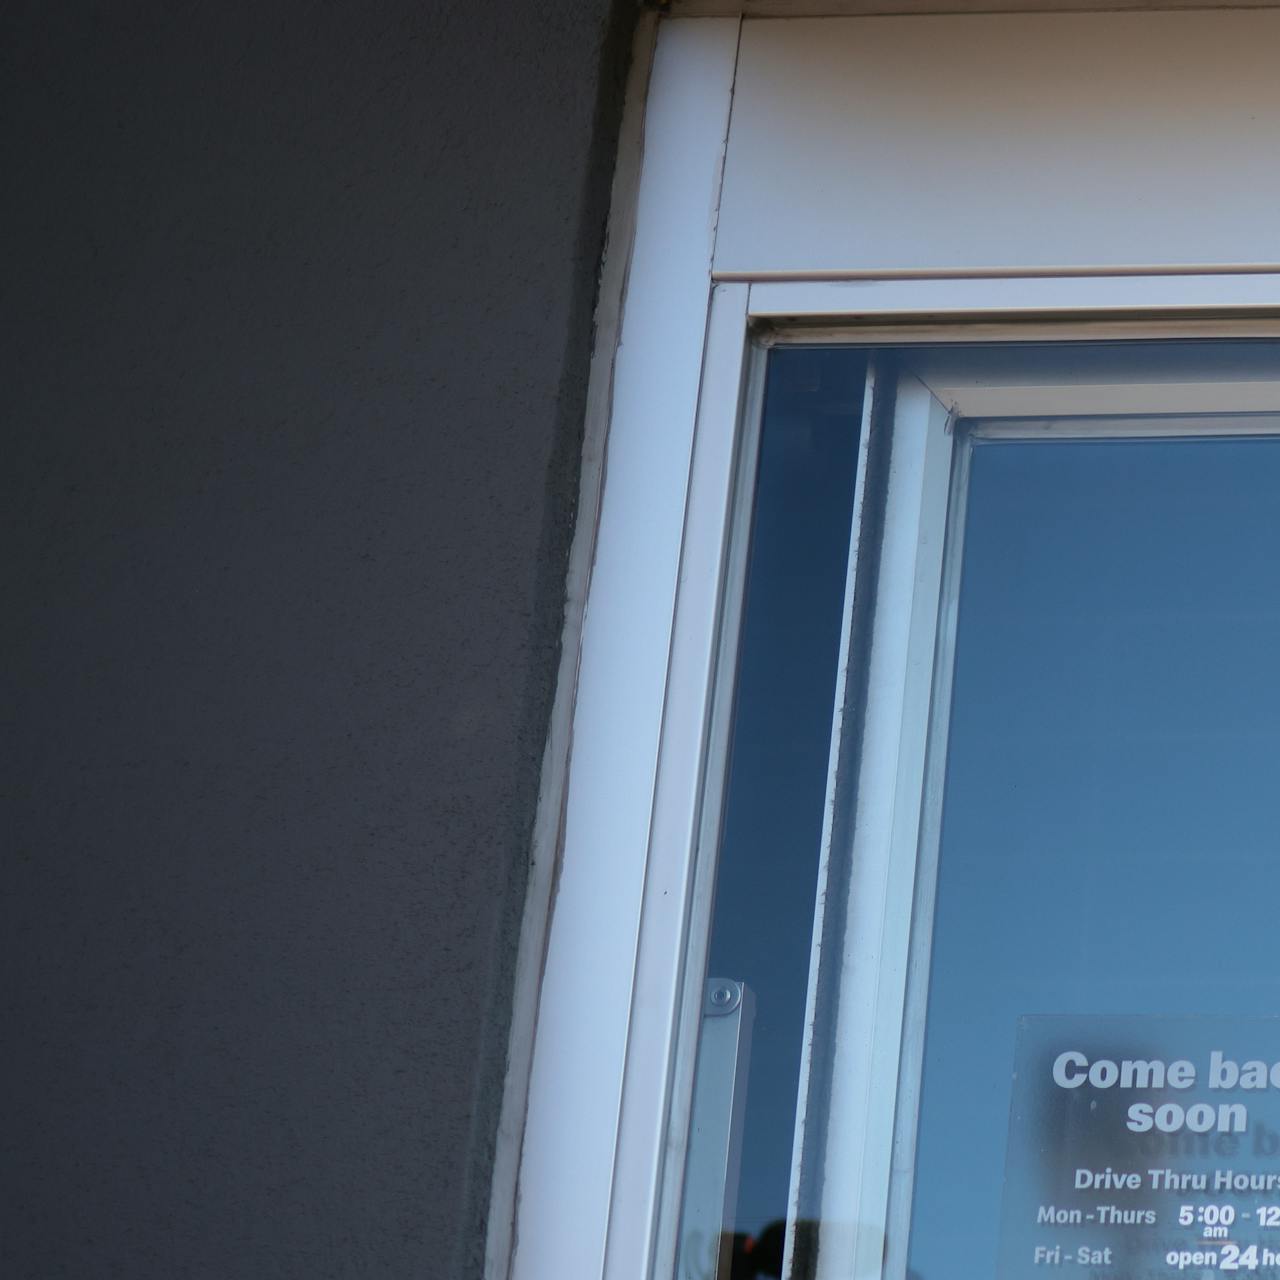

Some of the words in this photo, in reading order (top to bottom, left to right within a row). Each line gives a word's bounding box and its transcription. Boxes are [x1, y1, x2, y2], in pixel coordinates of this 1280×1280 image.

[1052, 1051, 1196, 1089] Come
[1126, 1103, 1248, 1133] soon
[1074, 1168, 1141, 1190] Drive
[1148, 1169, 1207, 1191] Thru
[1203, 1225, 1228, 1238] am
[1166, 1251, 1217, 1270] open
[1219, 1245, 1258, 1270] 24
